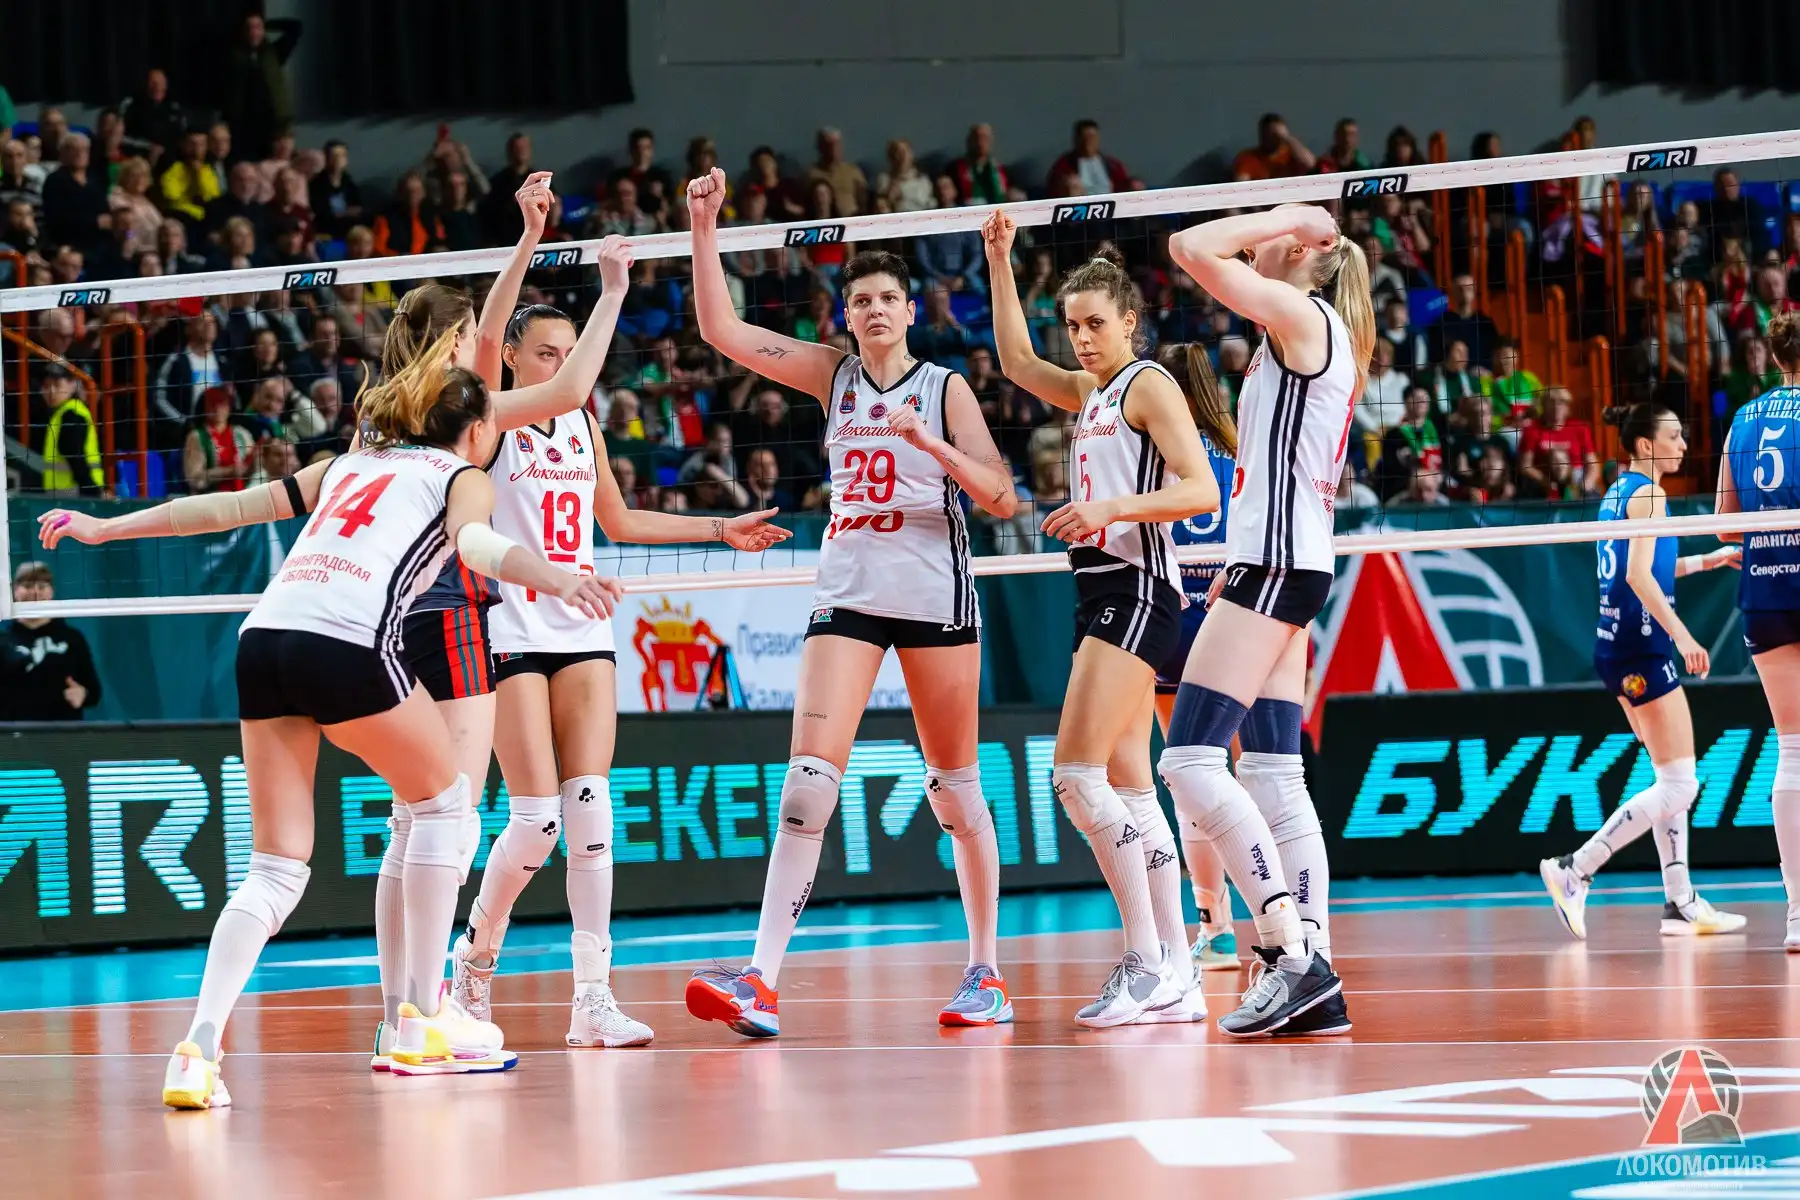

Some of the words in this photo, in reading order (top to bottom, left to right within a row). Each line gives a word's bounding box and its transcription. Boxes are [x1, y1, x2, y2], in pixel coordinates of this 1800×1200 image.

[1632, 149, 1690, 170] PARI
[1348, 177, 1402, 197] PARI
[1057, 203, 1109, 222] PARI
[789, 227, 839, 244] PARI
[530, 249, 577, 268] PARI
[287, 271, 332, 288] PARI
[62, 290, 106, 305] PARI
[1753, 424, 1786, 492] 5
[842, 450, 895, 503] 29
[306, 473, 396, 539] 14
[541, 491, 580, 551] 13
[1228, 567, 1248, 587] 17
[1100, 607, 1116, 625] 5
[1251, 843, 1271, 881] MIKASA
[1298, 868, 1309, 904] MIKASA
[792, 881, 812, 919] MIKASA
